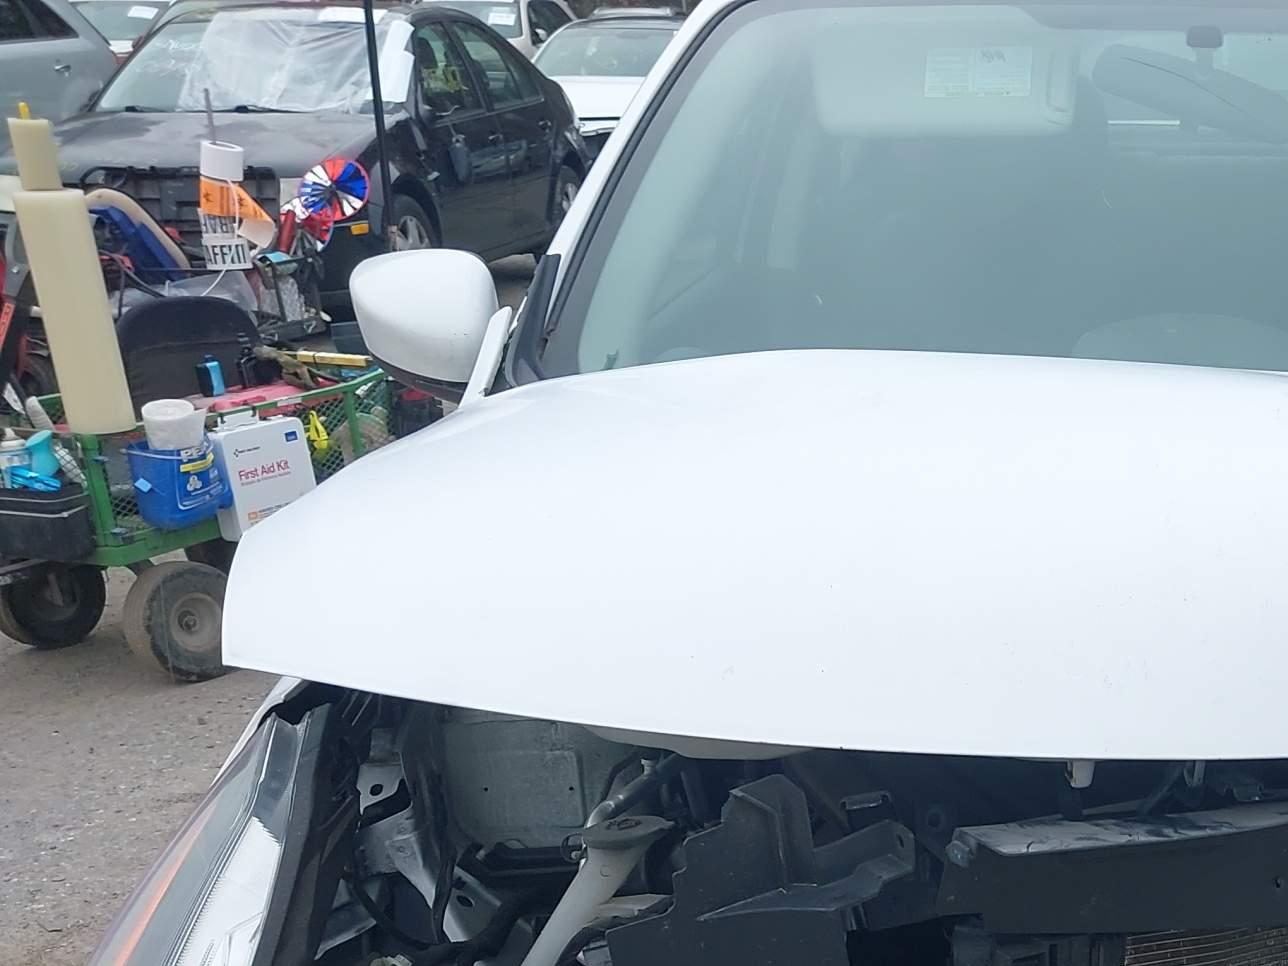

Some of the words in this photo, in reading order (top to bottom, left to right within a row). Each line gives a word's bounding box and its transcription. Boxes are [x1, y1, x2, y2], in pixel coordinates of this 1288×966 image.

[238, 467, 260, 481] First
[261, 461, 276, 476] Aid
[276, 458, 291, 473] Kit
